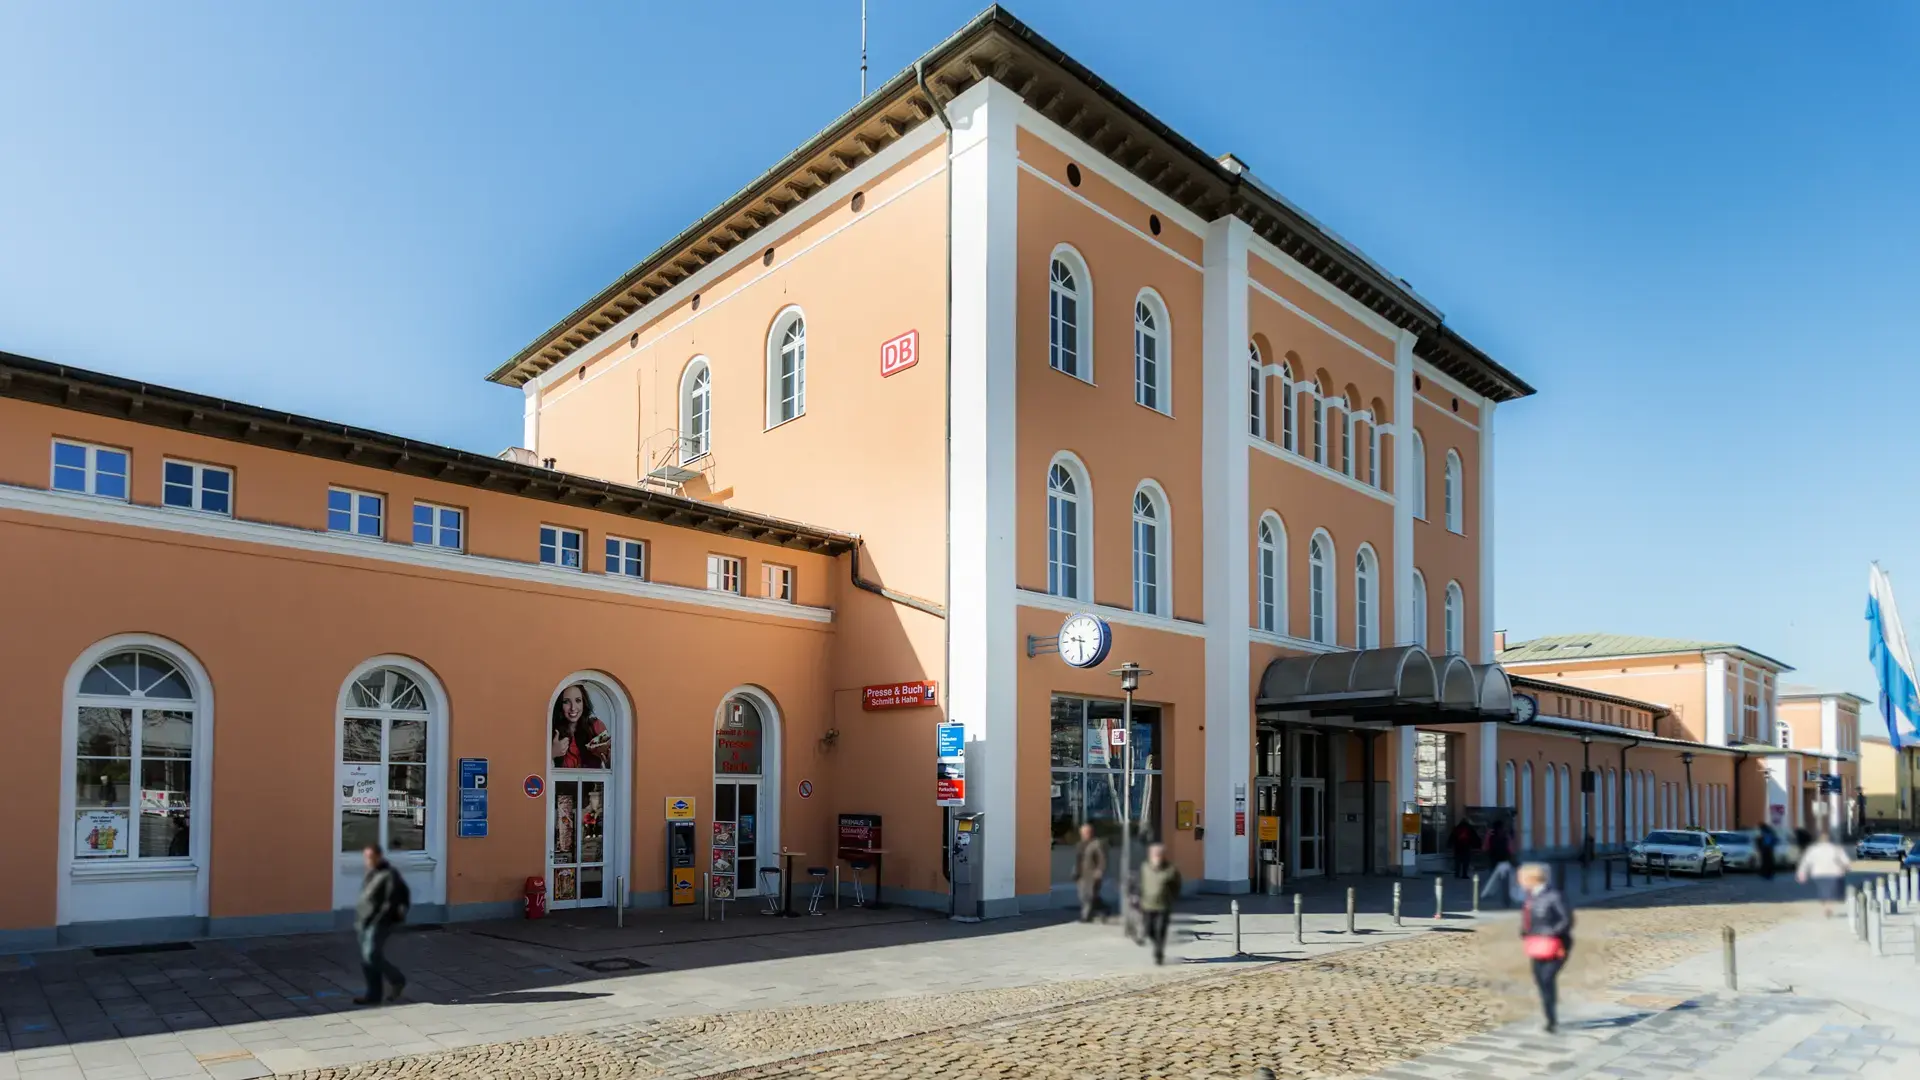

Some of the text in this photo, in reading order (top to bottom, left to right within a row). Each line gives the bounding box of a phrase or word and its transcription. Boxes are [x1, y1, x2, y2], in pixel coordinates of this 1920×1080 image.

[885, 337, 912, 369] DB
[867, 684, 922, 697] Presse & Buch
[872, 697, 894, 706] Schmitt
[895, 696, 900, 704] &
[357, 779, 376, 787] Coffee
[475, 775, 485, 788] P
[365, 786, 374, 794] go
[975, 823, 980, 832] P
